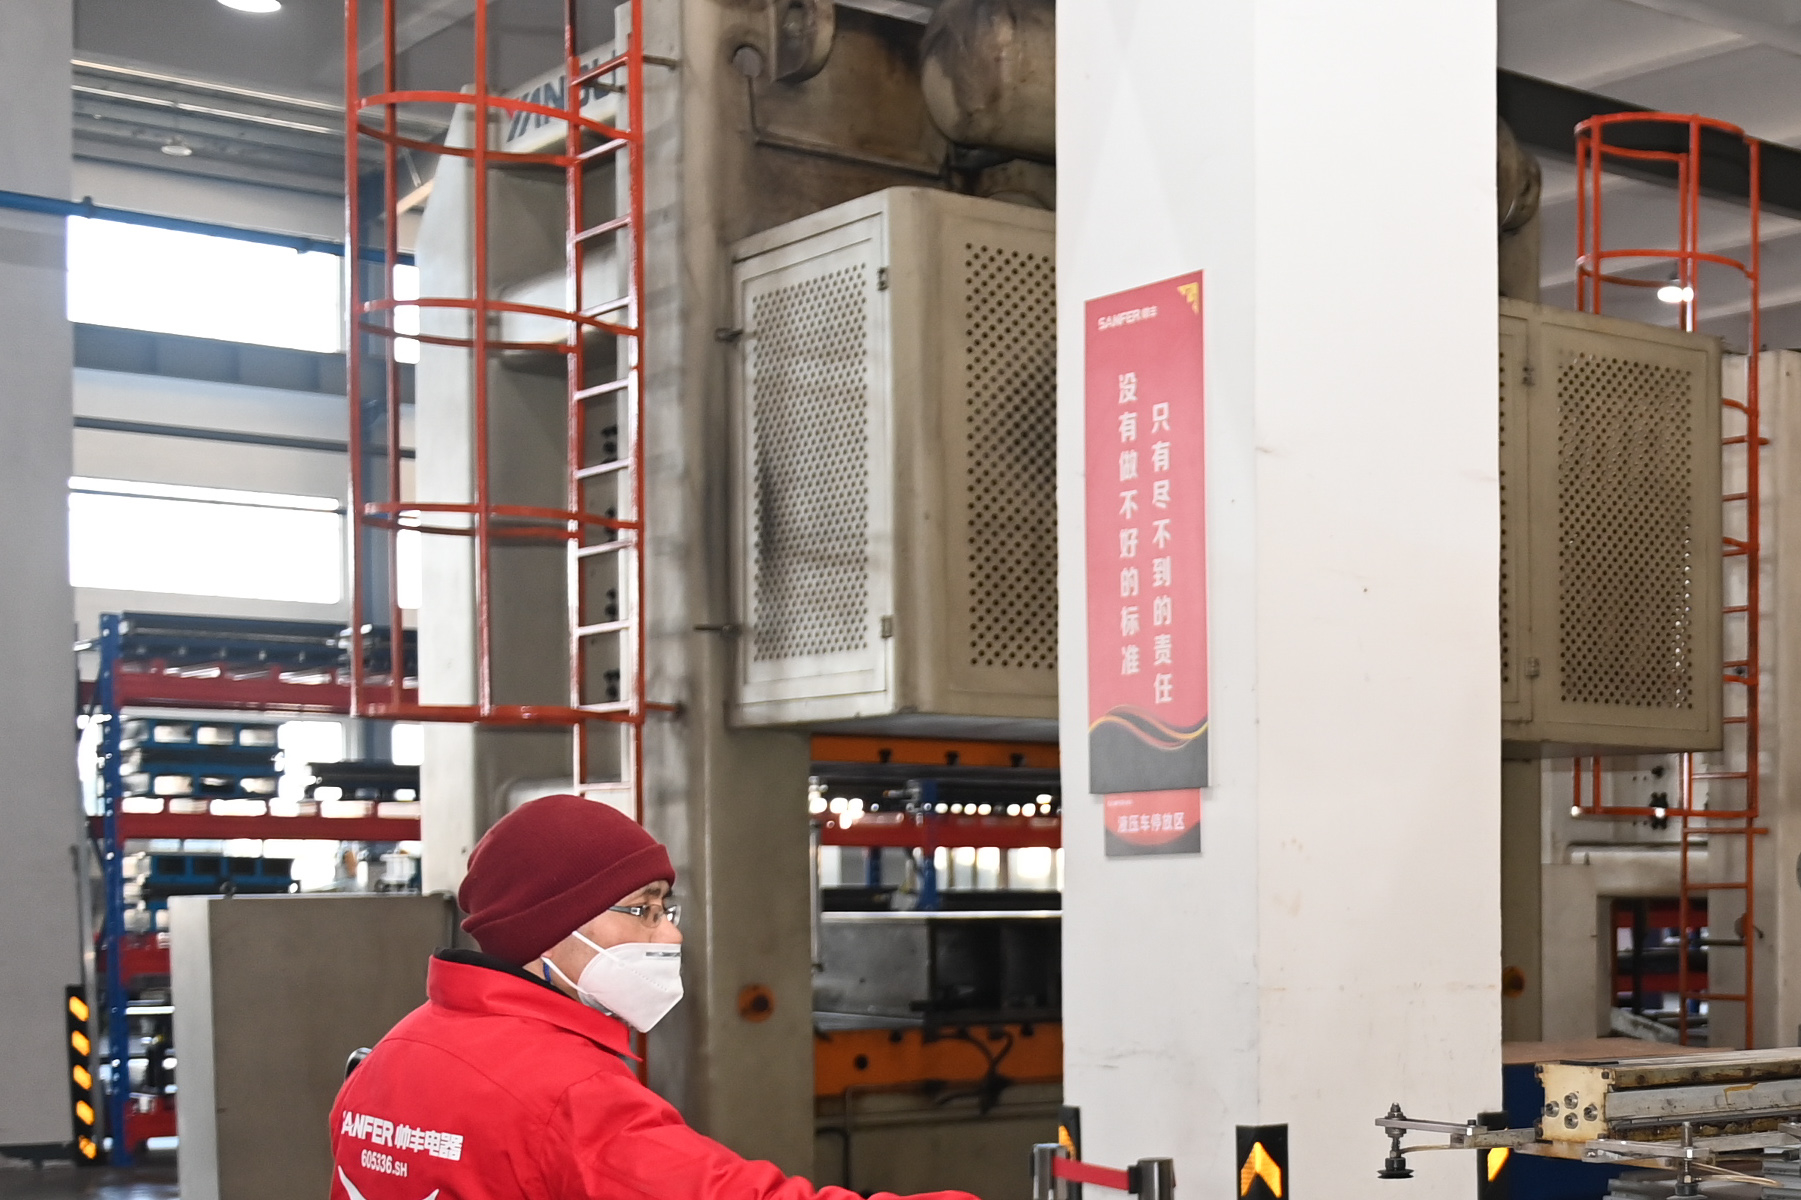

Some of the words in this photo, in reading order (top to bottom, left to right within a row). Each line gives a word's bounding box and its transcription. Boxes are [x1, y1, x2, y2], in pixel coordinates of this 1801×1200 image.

[1118, 372, 1140, 676] 没有做不好的标准
[1152, 402, 1173, 704] 只有尽不到的责任
[341, 1110, 395, 1147] ANFER
[394, 1123, 464, 1161] 帅丰电器
[361, 1149, 408, 1177] 605336.SH
